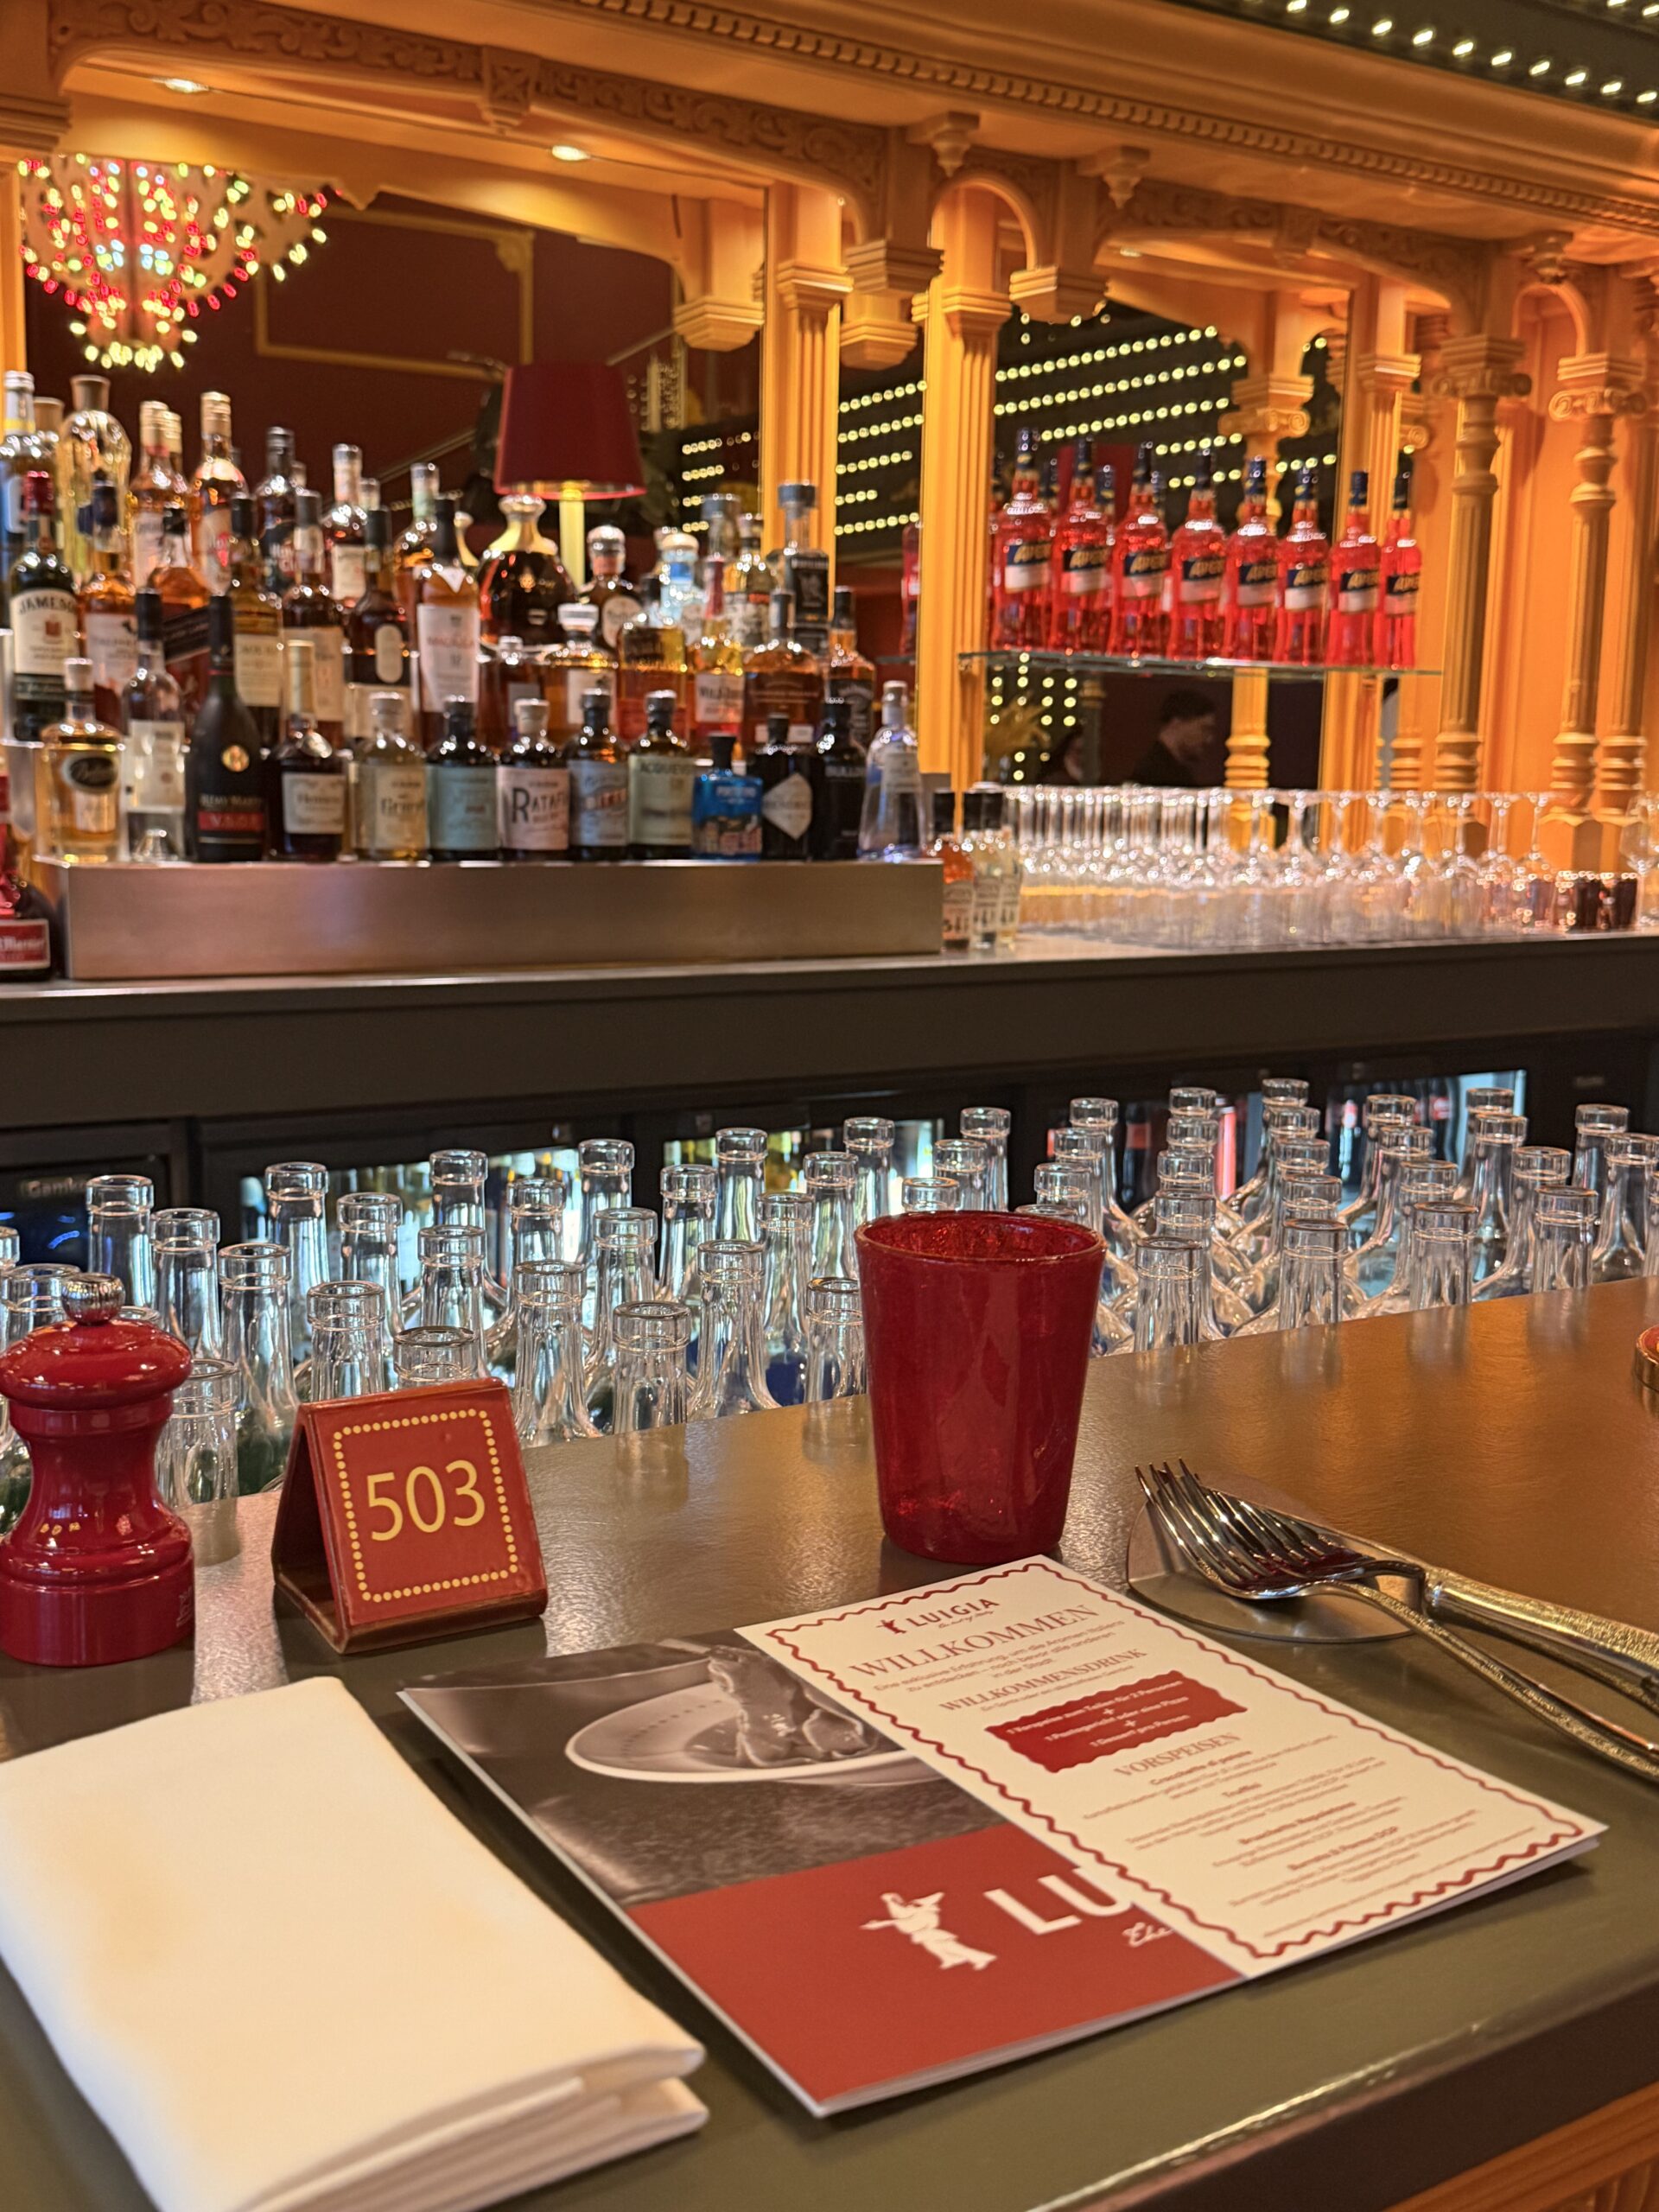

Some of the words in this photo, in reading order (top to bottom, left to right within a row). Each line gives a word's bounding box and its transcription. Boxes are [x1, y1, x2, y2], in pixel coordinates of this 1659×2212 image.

[19, 595, 76, 614] JAMESO
[366, 1459, 486, 1541] 503
[905, 1598, 1000, 1627] LUIGIA
[849, 1604, 1099, 1676] WILLKOMMEN
[938, 1648, 1147, 1710] WILLKOMMENSDRINK
[1113, 1733, 1241, 1776] VORSPEISEN
